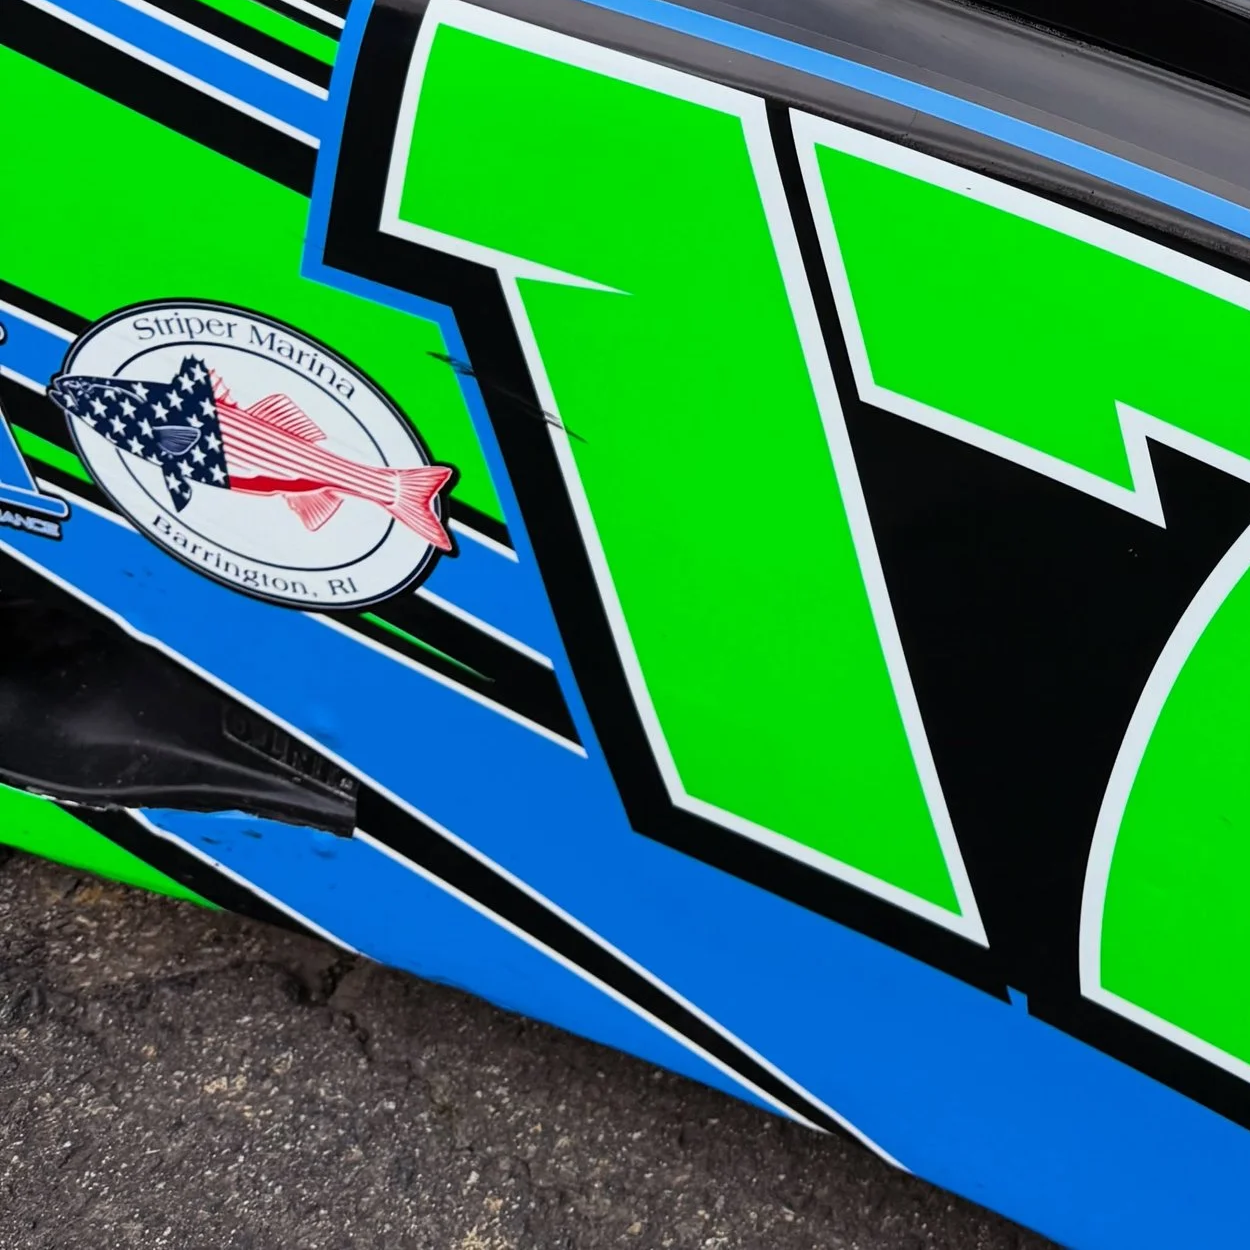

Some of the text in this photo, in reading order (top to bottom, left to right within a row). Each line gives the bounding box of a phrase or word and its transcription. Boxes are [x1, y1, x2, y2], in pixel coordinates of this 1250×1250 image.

[132, 311, 357, 401] Striper Marina
[151, 513, 360, 597] Barrington, RI
